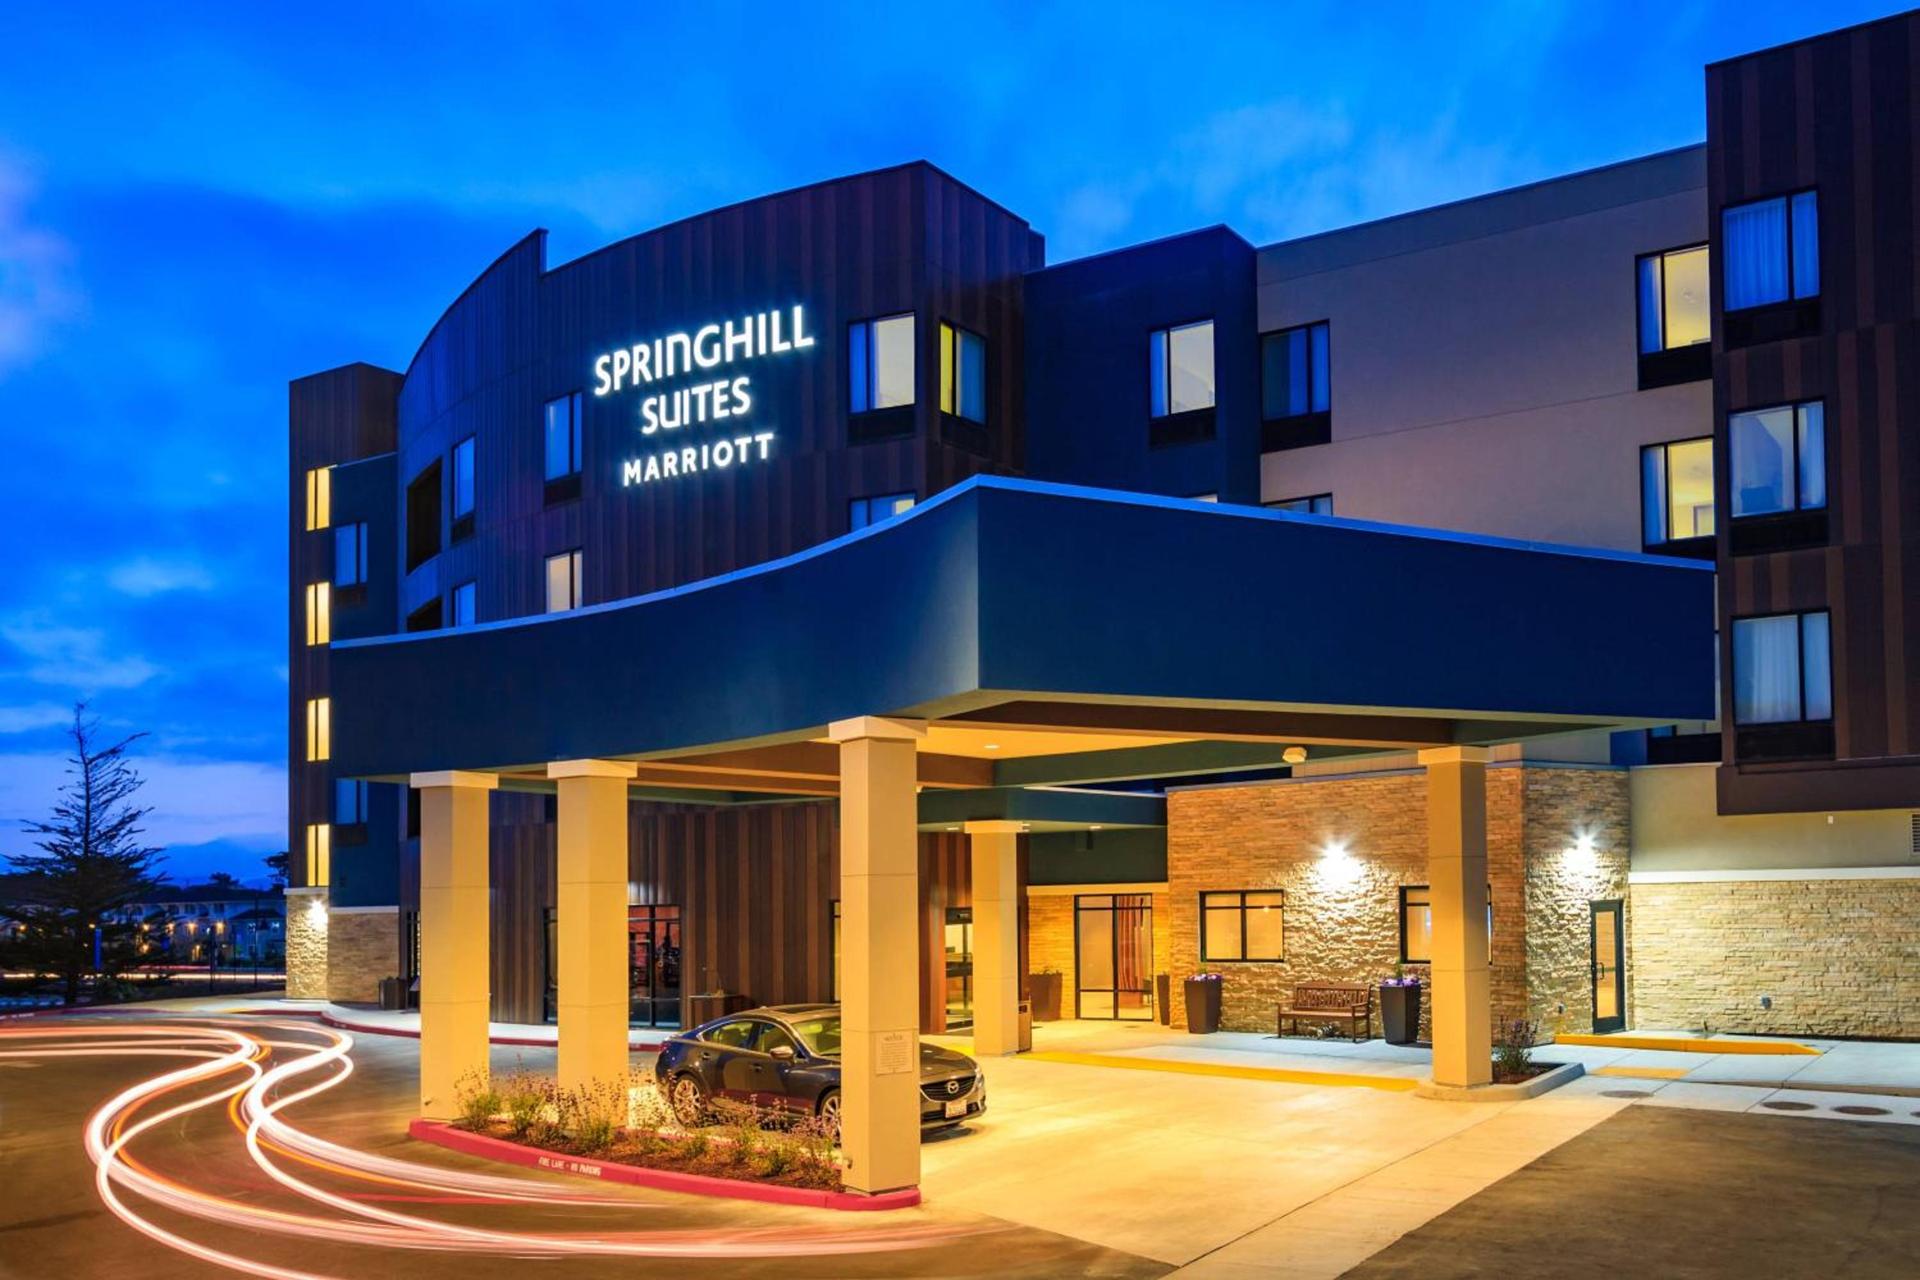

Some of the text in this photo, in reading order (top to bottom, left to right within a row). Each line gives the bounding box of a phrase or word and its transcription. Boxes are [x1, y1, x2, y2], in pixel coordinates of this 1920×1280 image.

[594, 305, 814, 396] SPRINGHILL
[642, 377, 751, 435] SUITES
[623, 432, 774, 486] MARRIOTT
